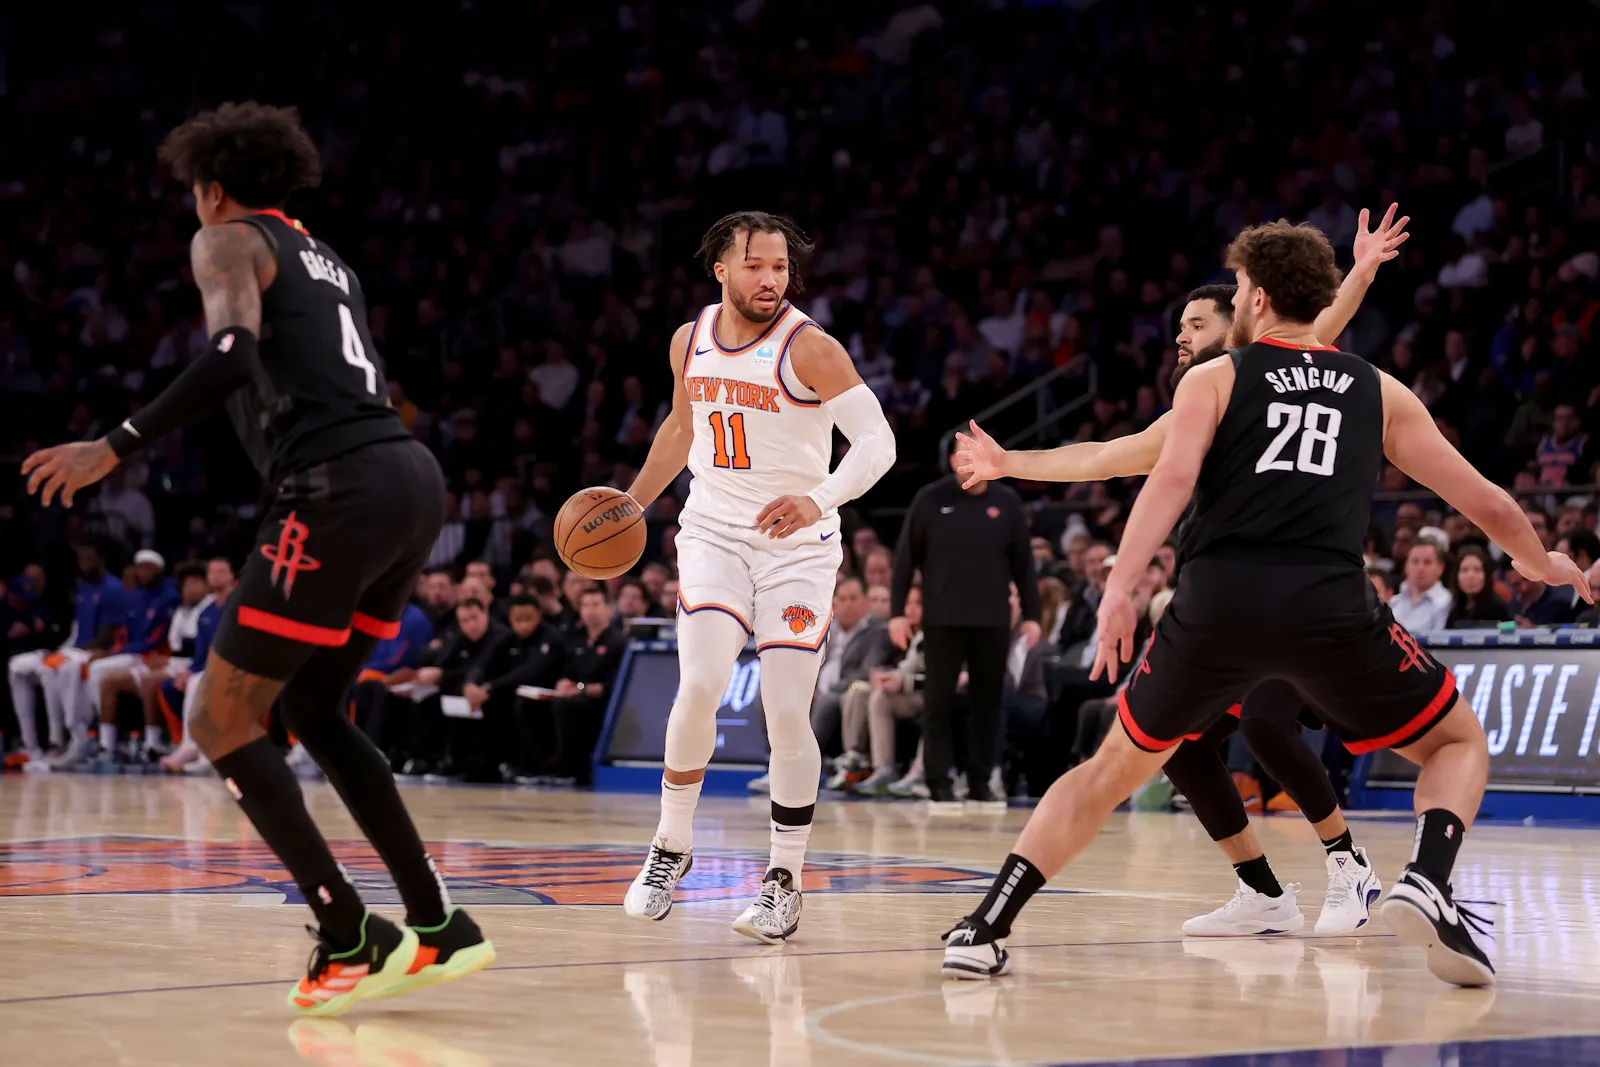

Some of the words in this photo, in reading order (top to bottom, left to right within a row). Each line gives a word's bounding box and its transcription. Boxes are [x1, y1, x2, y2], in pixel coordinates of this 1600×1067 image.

[338, 303, 377, 395] 4
[686, 377, 721, 402] NEW
[723, 379, 780, 413] YORK
[1264, 366, 1355, 394] SENGUN
[708, 411, 751, 470] 11
[1255, 402, 1342, 476] 28
[582, 501, 637, 534] Wilson
[1453, 663, 1580, 756] TASTE
